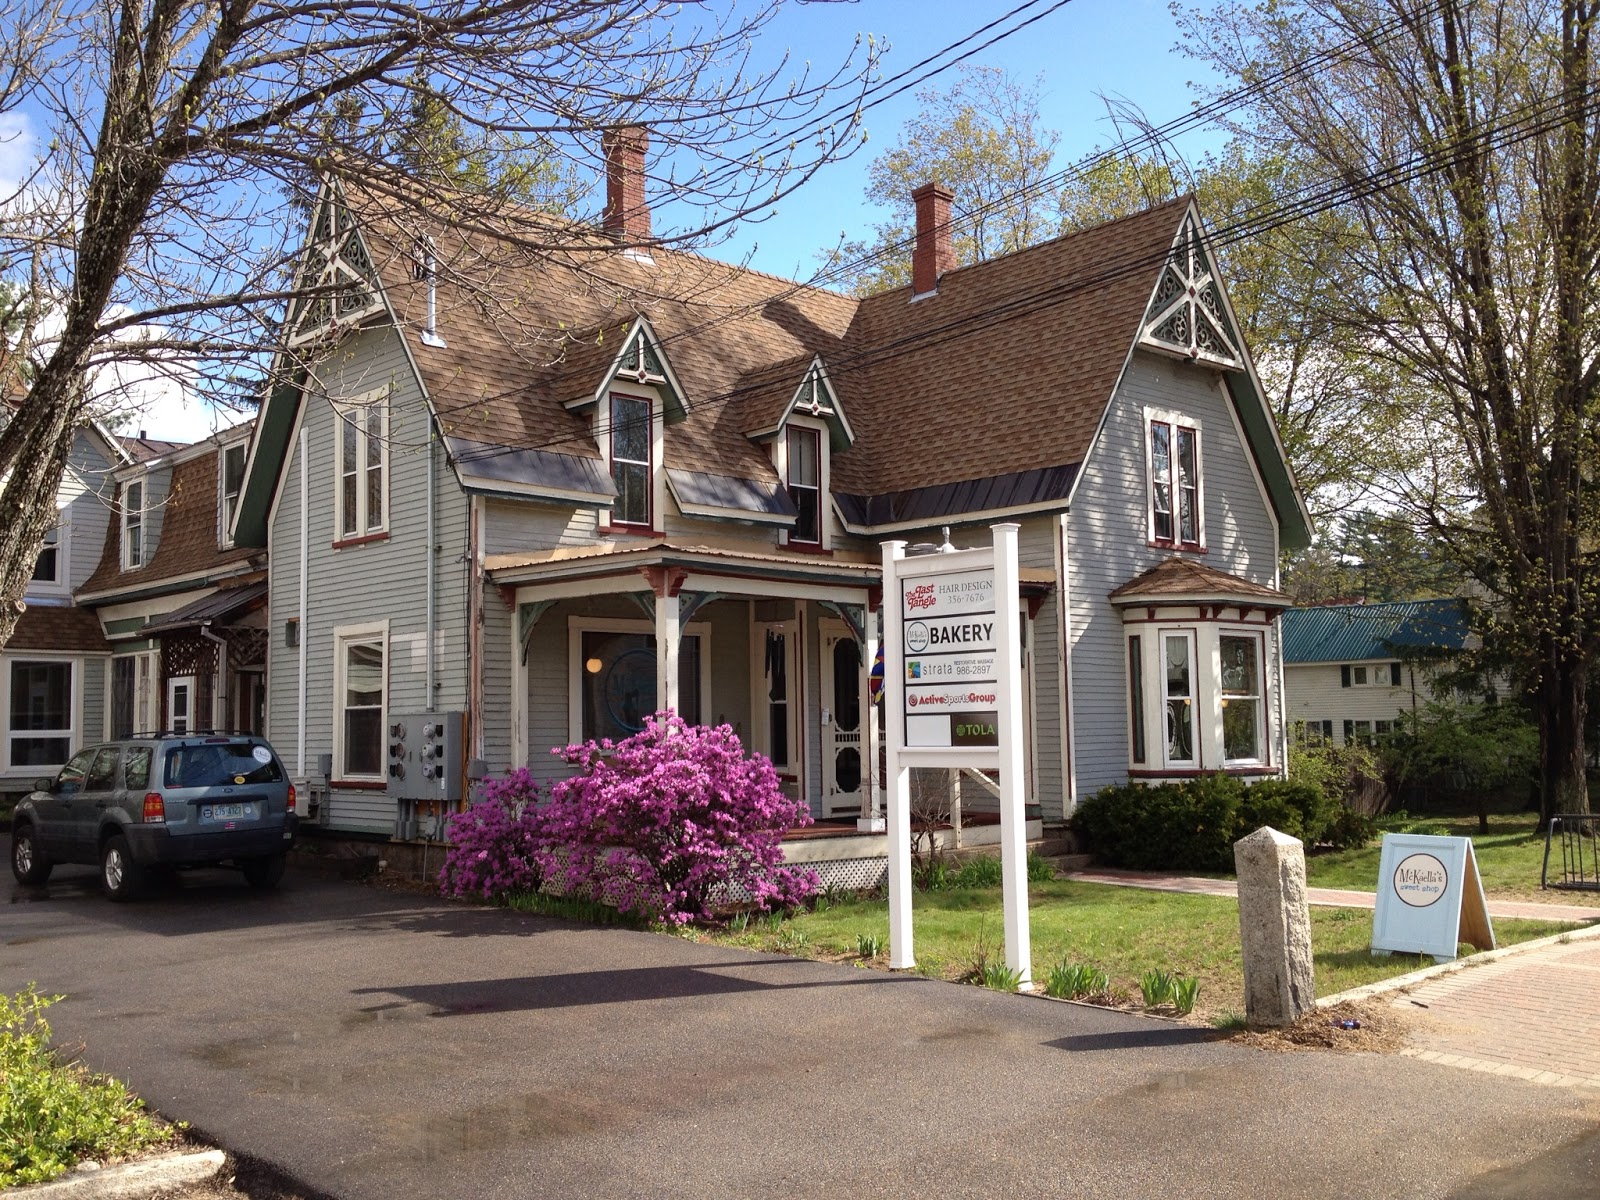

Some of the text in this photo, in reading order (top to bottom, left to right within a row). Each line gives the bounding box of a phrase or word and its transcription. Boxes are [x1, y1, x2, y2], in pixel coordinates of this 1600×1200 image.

[915, 584, 935, 599] Last
[939, 580, 993, 594] HAIR DESIGN
[907, 595, 936, 611] Tangle
[947, 593, 985, 604] 356-7676
[930, 623, 993, 644] BAKERY
[922, 663, 952, 675] strata
[956, 665, 991, 675] 986-2897
[965, 724, 996, 736] TOLA
[1399, 868, 1443, 884] McKaella's
[1422, 885, 1439, 893] shop
